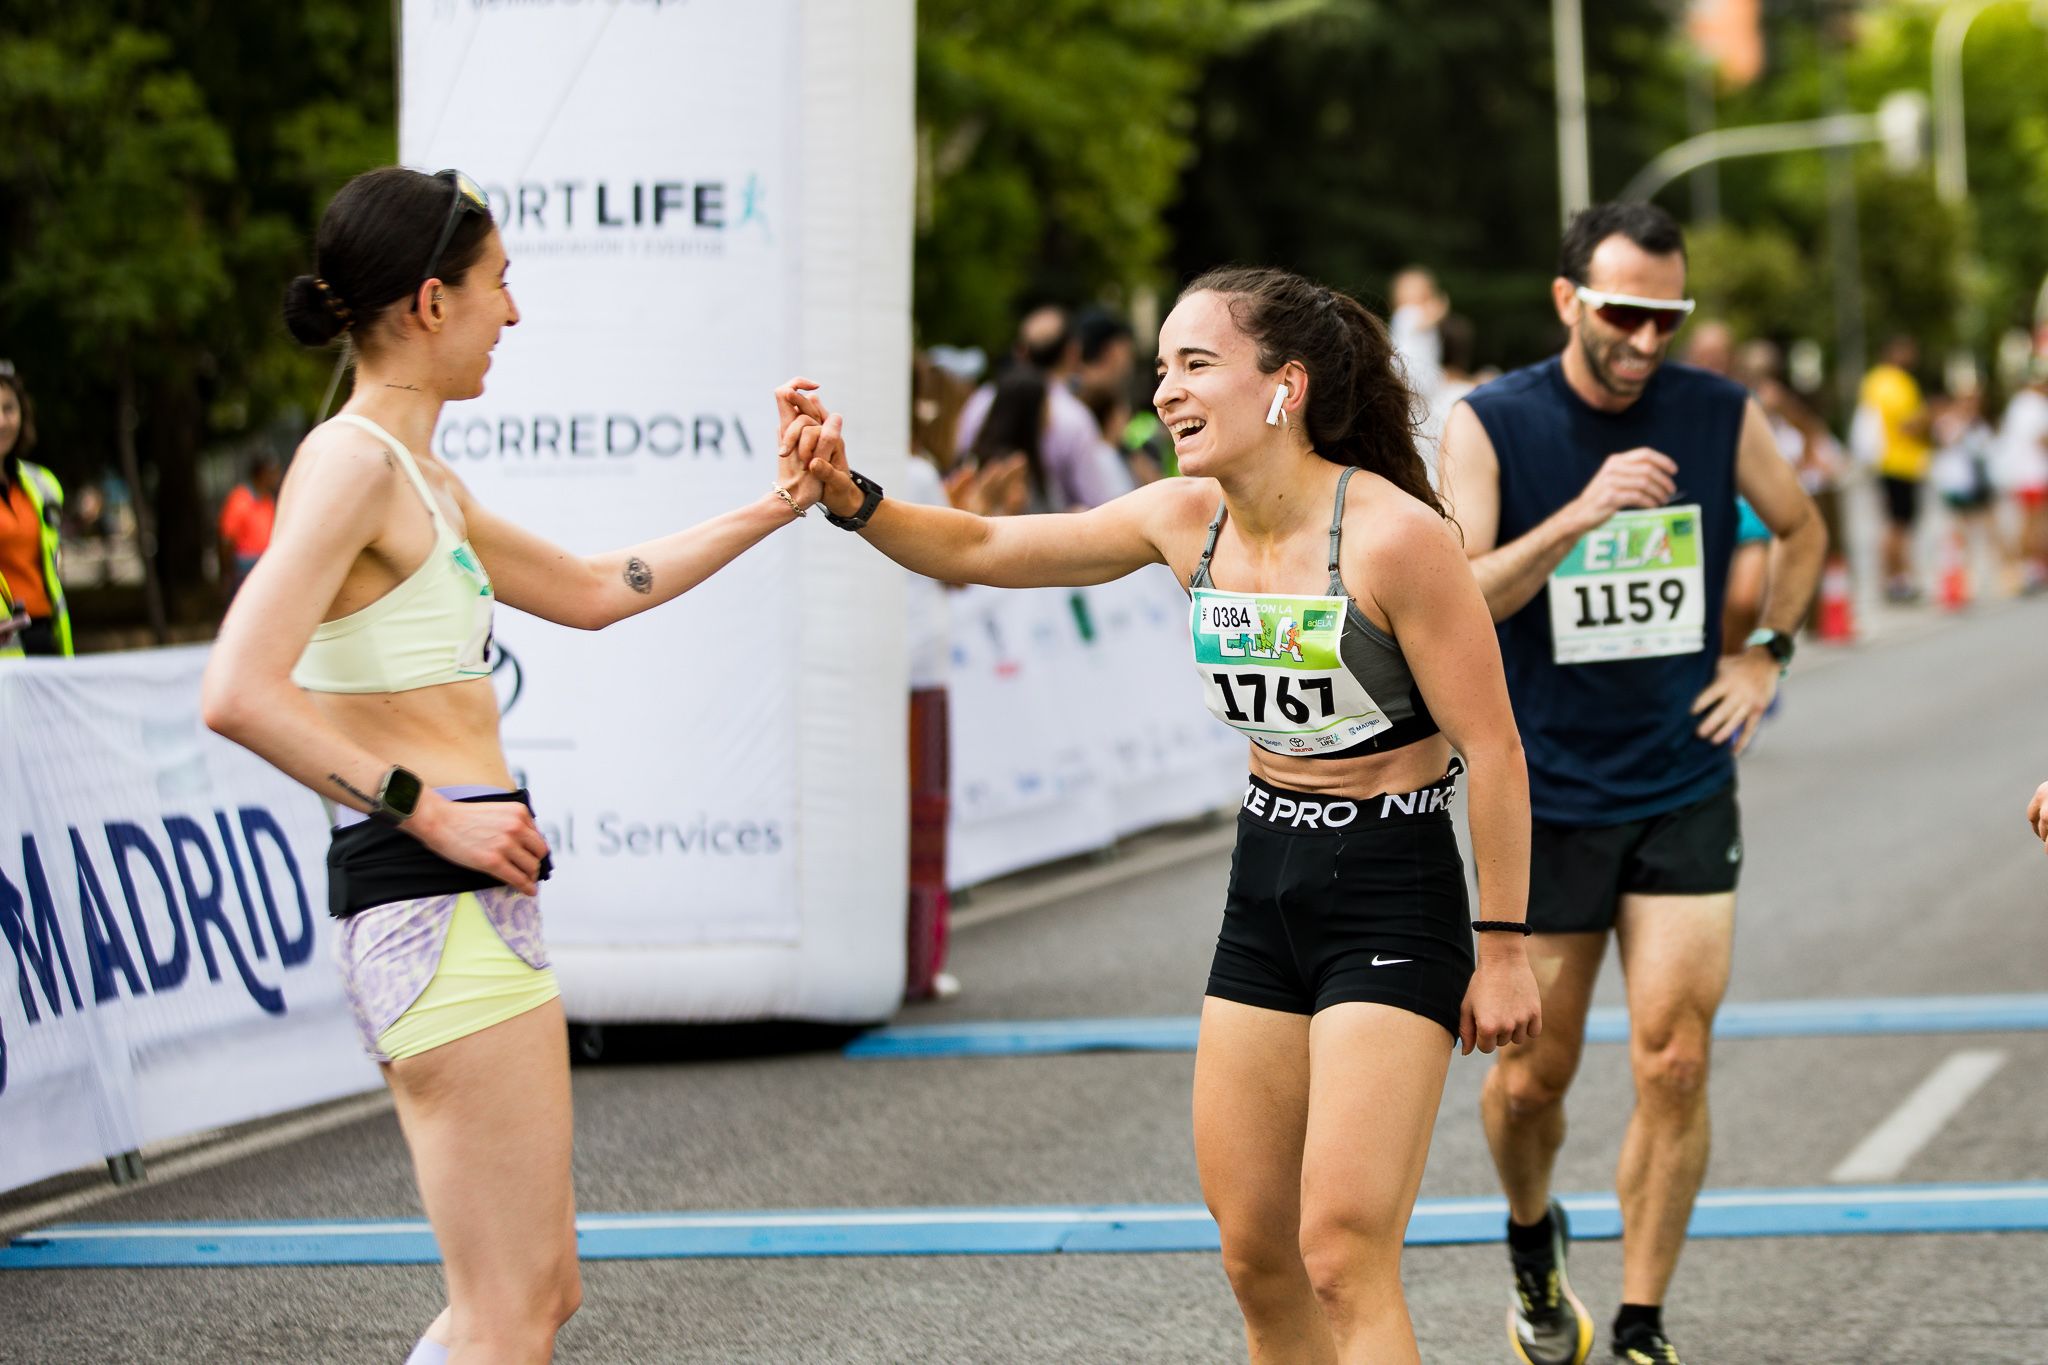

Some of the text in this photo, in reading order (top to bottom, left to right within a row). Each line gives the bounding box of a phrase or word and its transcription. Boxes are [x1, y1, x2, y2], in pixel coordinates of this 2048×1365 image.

[484, 181, 726, 229] ORT LIFE
[1585, 526, 1673, 570] ELA
[1213, 606, 1251, 627] 0384
[1279, 605, 1292, 614] LA
[1574, 579, 1685, 628] 1159
[1213, 673, 1336, 724] 1767
[1315, 734, 1334, 743] SPORT
[1320, 739, 1336, 747] LIFE
[1355, 719, 1380, 731] MADRID
[1269, 796, 1358, 829] PRO
[599, 811, 783, 855] Services
[20, 805, 316, 1027] MADRID
